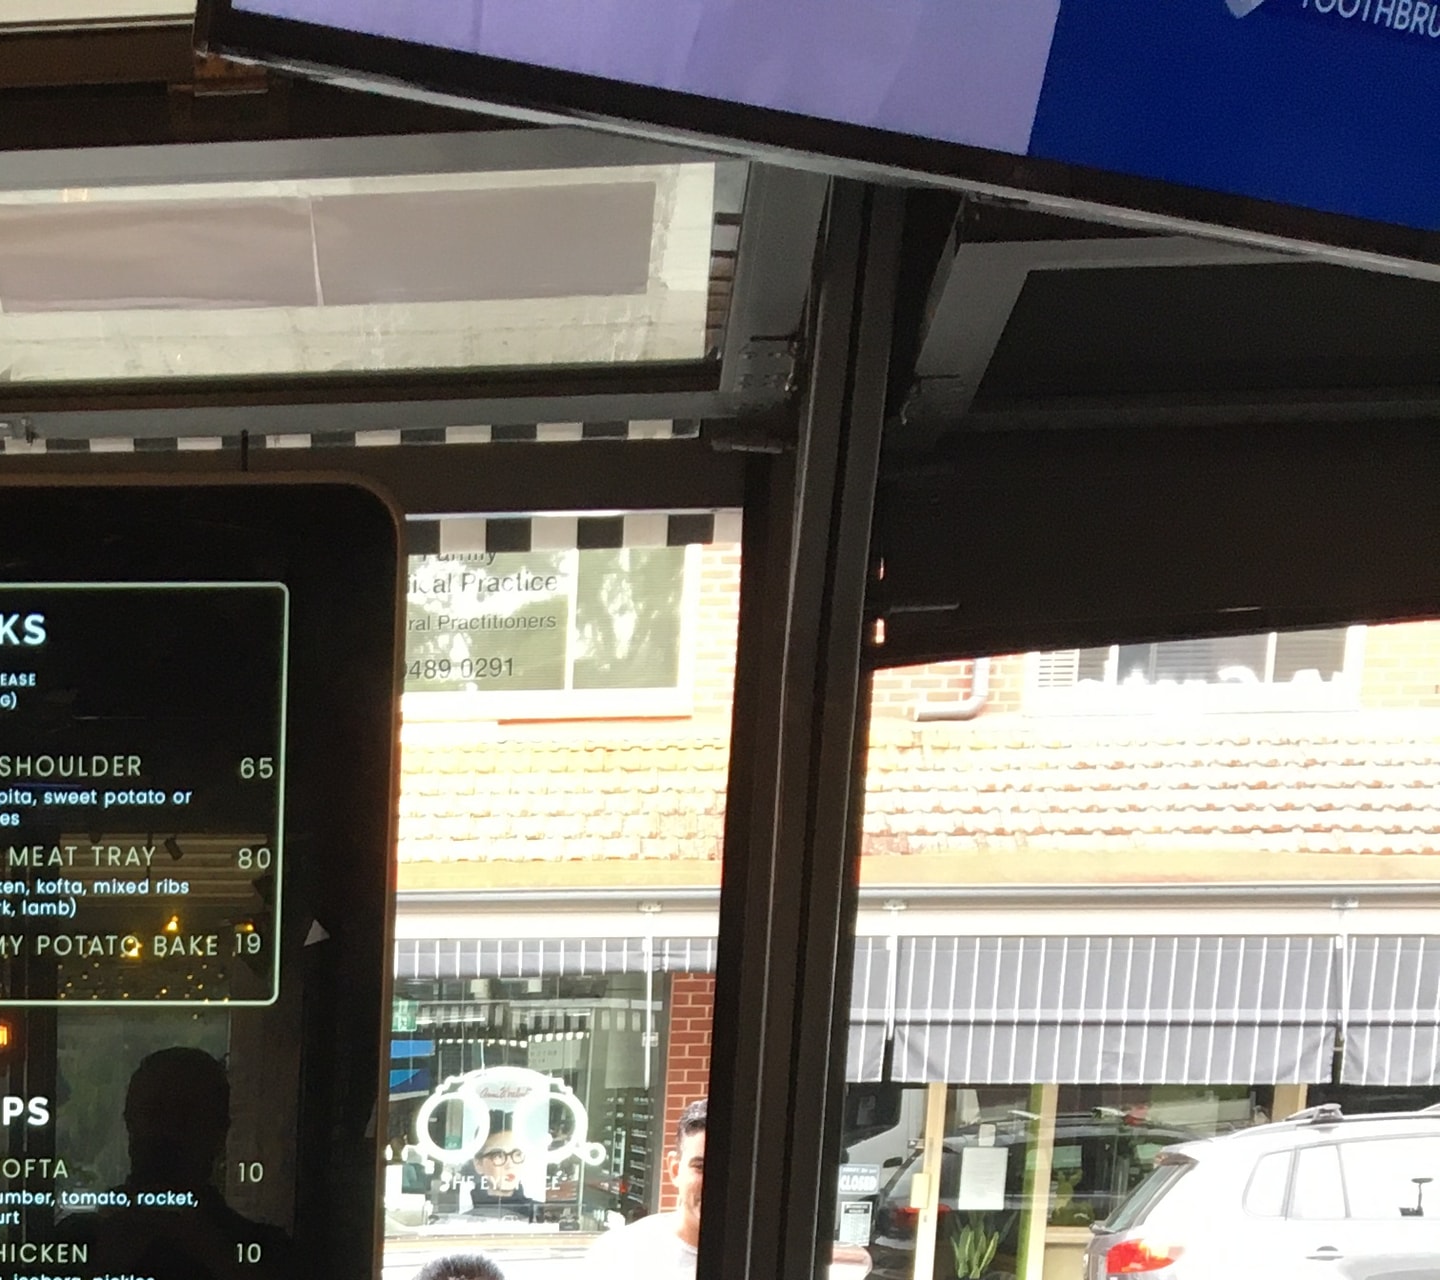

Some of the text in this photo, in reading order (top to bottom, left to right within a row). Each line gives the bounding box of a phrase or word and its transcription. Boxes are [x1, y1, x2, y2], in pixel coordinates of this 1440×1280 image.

[461, 570, 558, 593] Practice
[437, 613, 557, 631] Practitioners
[460, 657, 513, 678] 0291
[240, 756, 274, 779] 65
[8, 845, 78, 867] MEAT
[90, 845, 156, 867] TRAY
[237, 847, 272, 870] 80
[37, 934, 141, 957] POTATO
[153, 935, 218, 958] BAKE
[233, 932, 263, 956] 19
[238, 1162, 264, 1183] 10
[61, 1190, 131, 1208] tomato,
[137, 1190, 199, 1208] rocket,
[236, 1243, 262, 1264] 10
